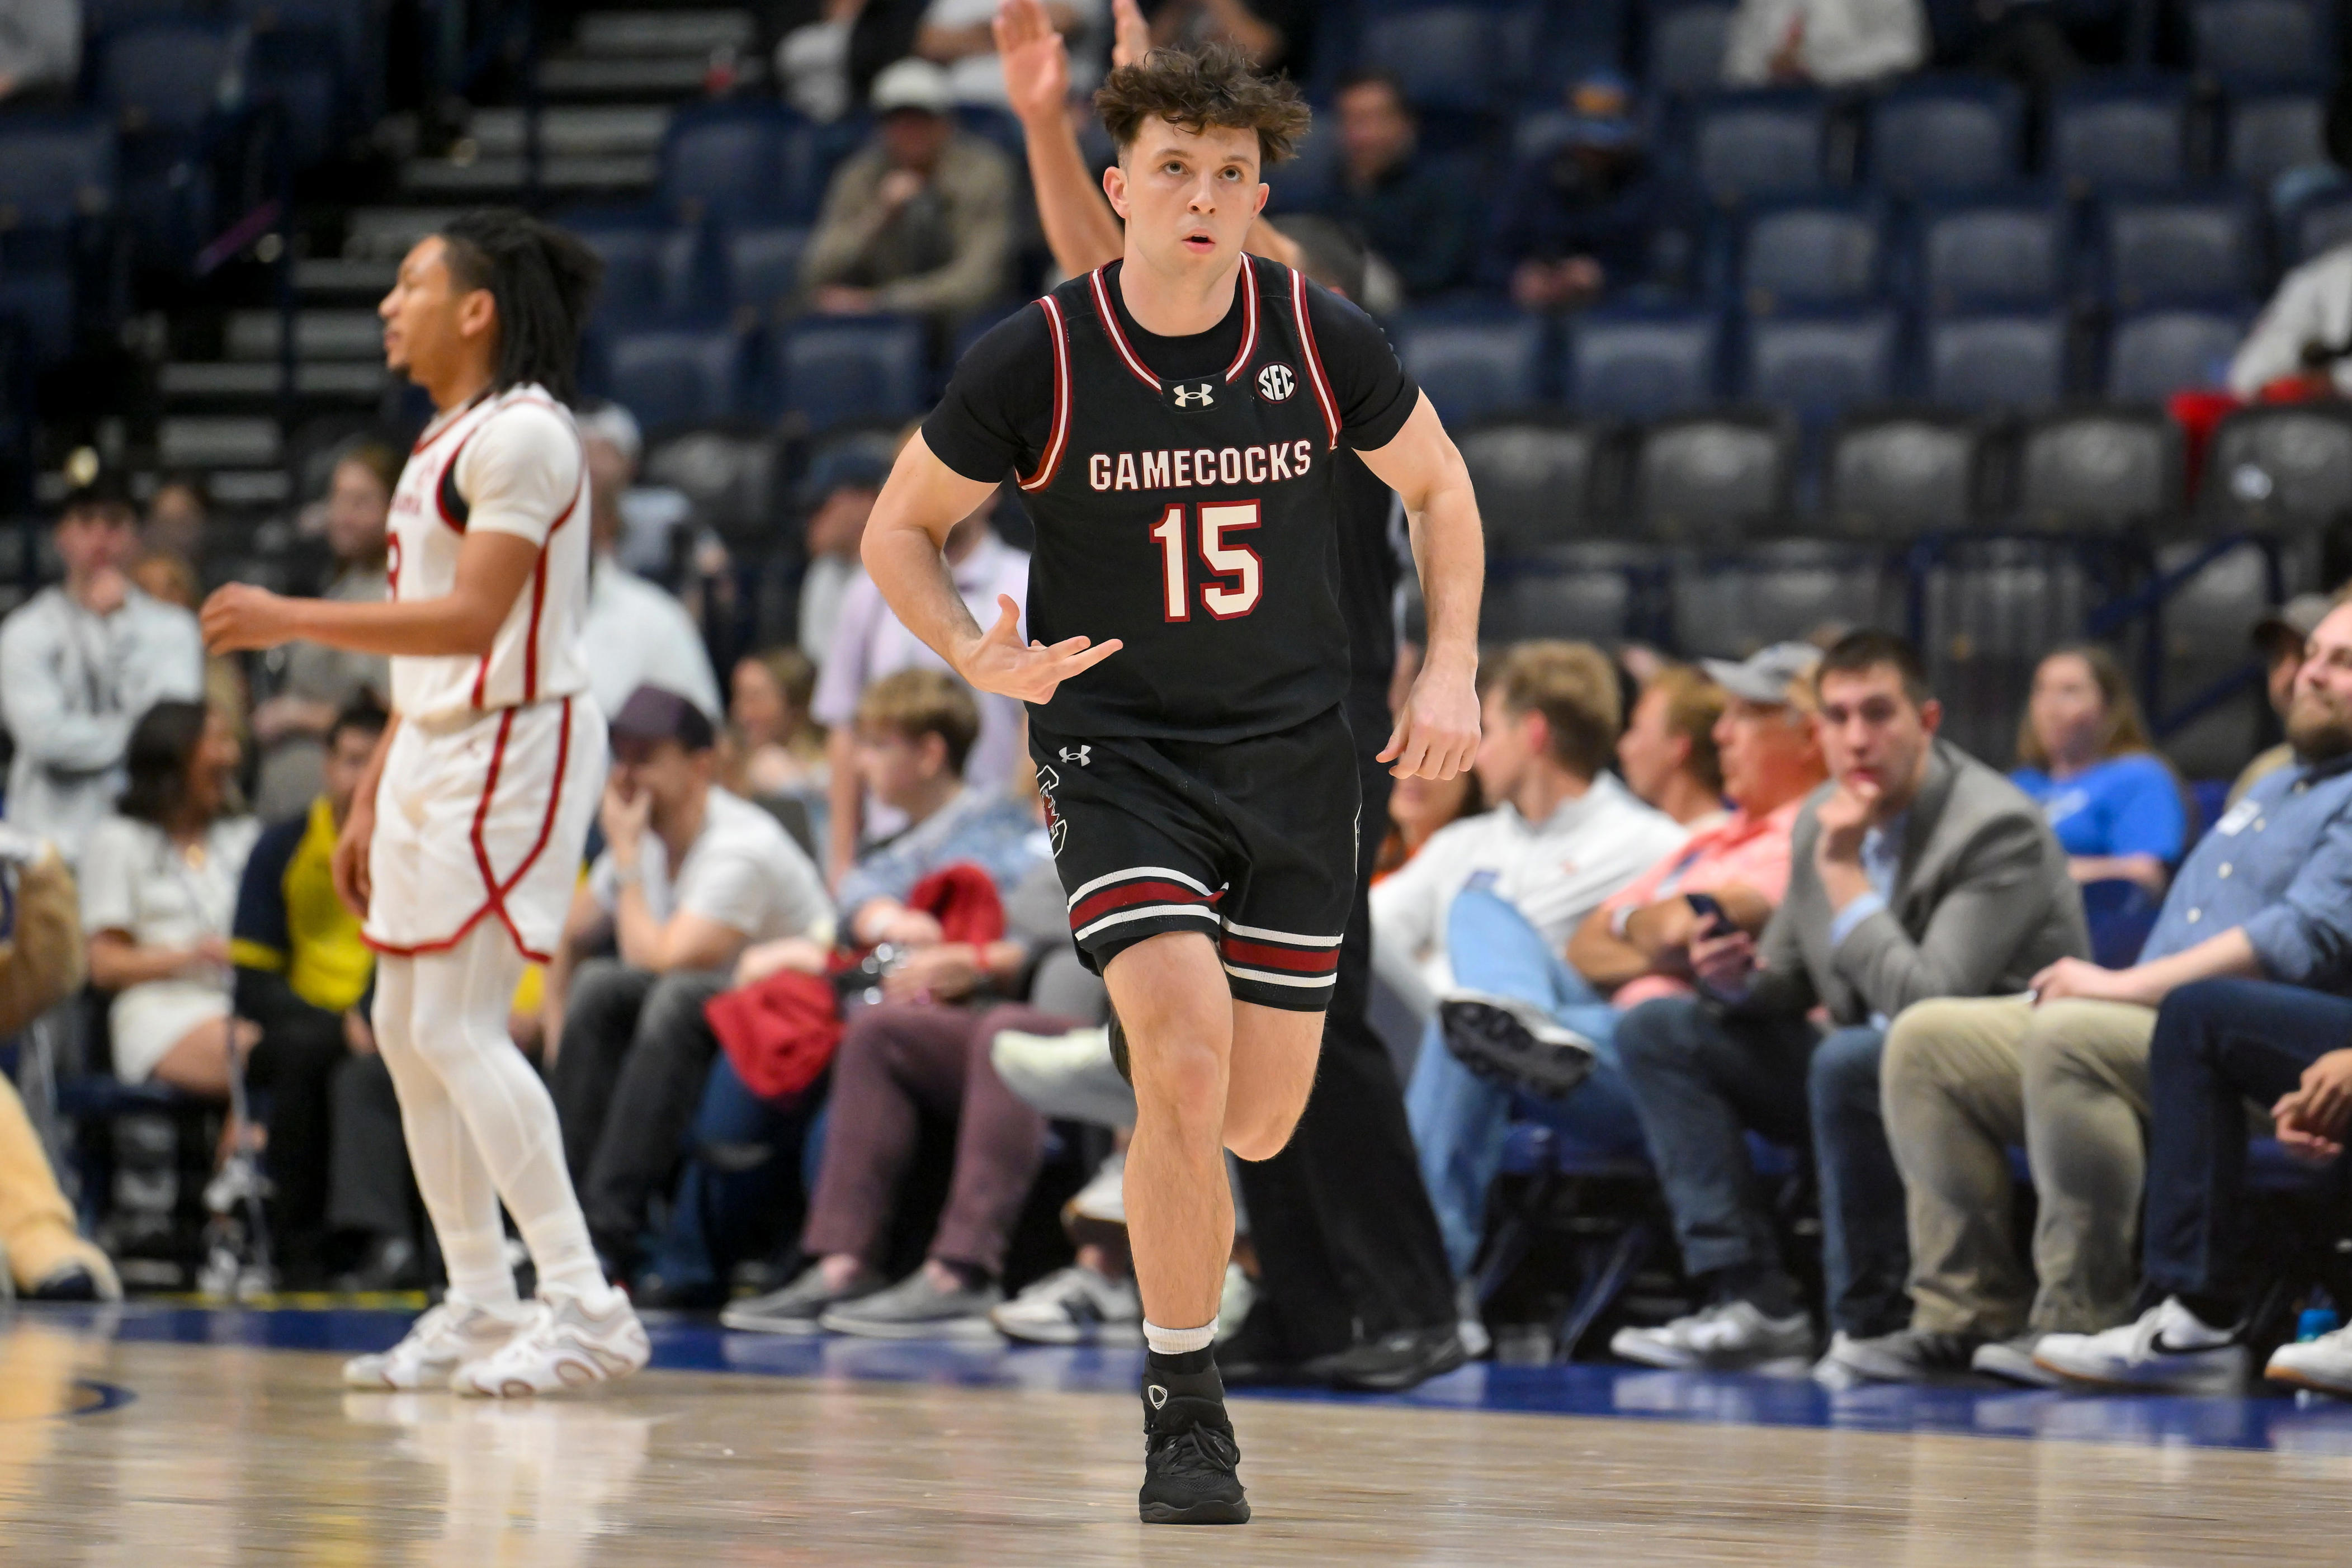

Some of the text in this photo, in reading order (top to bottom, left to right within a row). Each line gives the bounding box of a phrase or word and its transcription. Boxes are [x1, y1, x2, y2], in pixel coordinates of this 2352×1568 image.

[1258, 364, 1295, 400] SEC
[1089, 440, 1311, 491] GAMECOCKS
[1149, 498, 1263, 622] 15
